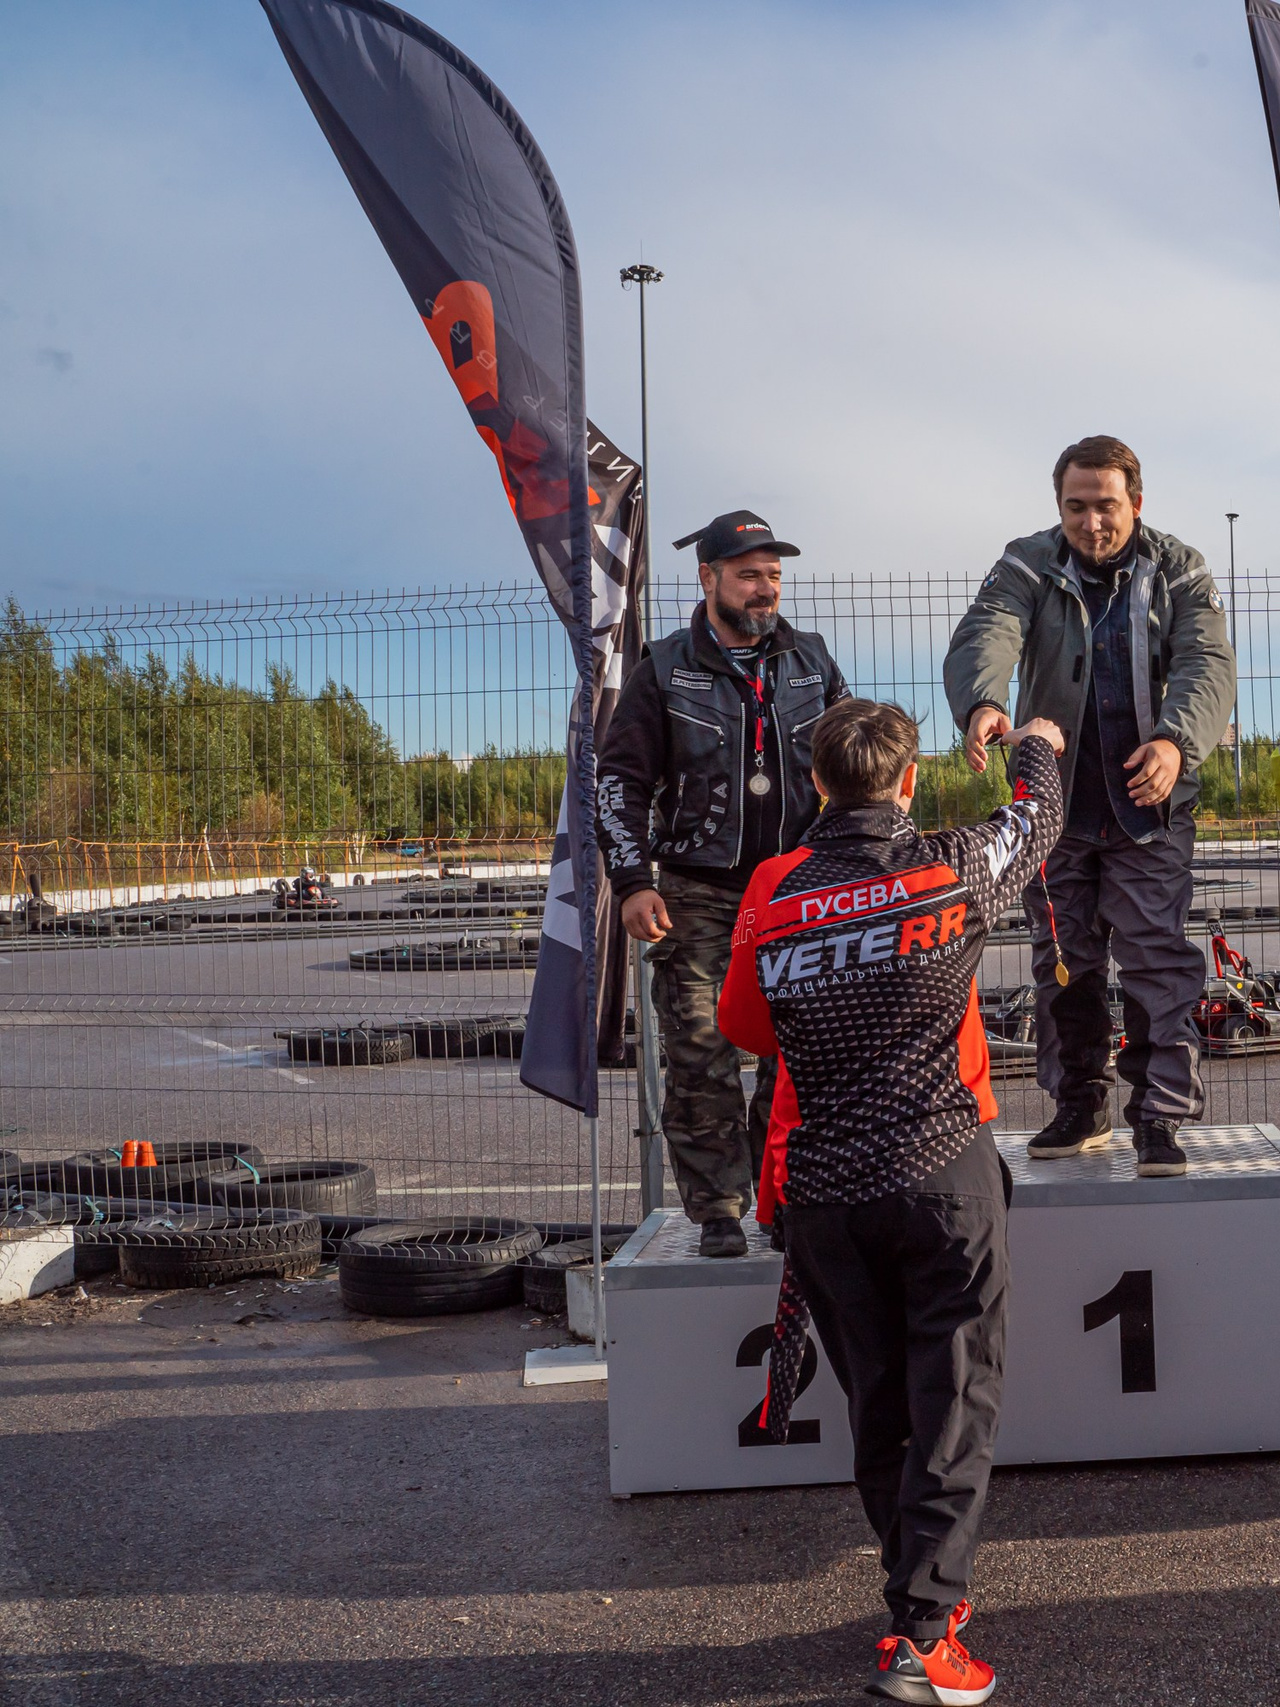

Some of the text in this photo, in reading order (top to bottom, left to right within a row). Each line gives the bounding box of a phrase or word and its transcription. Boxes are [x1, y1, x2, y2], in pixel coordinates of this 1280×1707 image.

[791, 674, 822, 686] MEMBER
[609, 783, 625, 809] THE
[658, 782, 728, 854] RUSSIA
[801, 880, 909, 923] ГУСЕВА
[761, 902, 968, 988] VETERR
[1210, 923, 1222, 935] 36
[766, 936, 967, 1002] ОФИЦИАЛЬНЫЙ ДИЛЕР
[1082, 1270, 1157, 1394] 1
[735, 1323, 821, 1448] 2
[946, 1652, 966, 1677] PUMA
